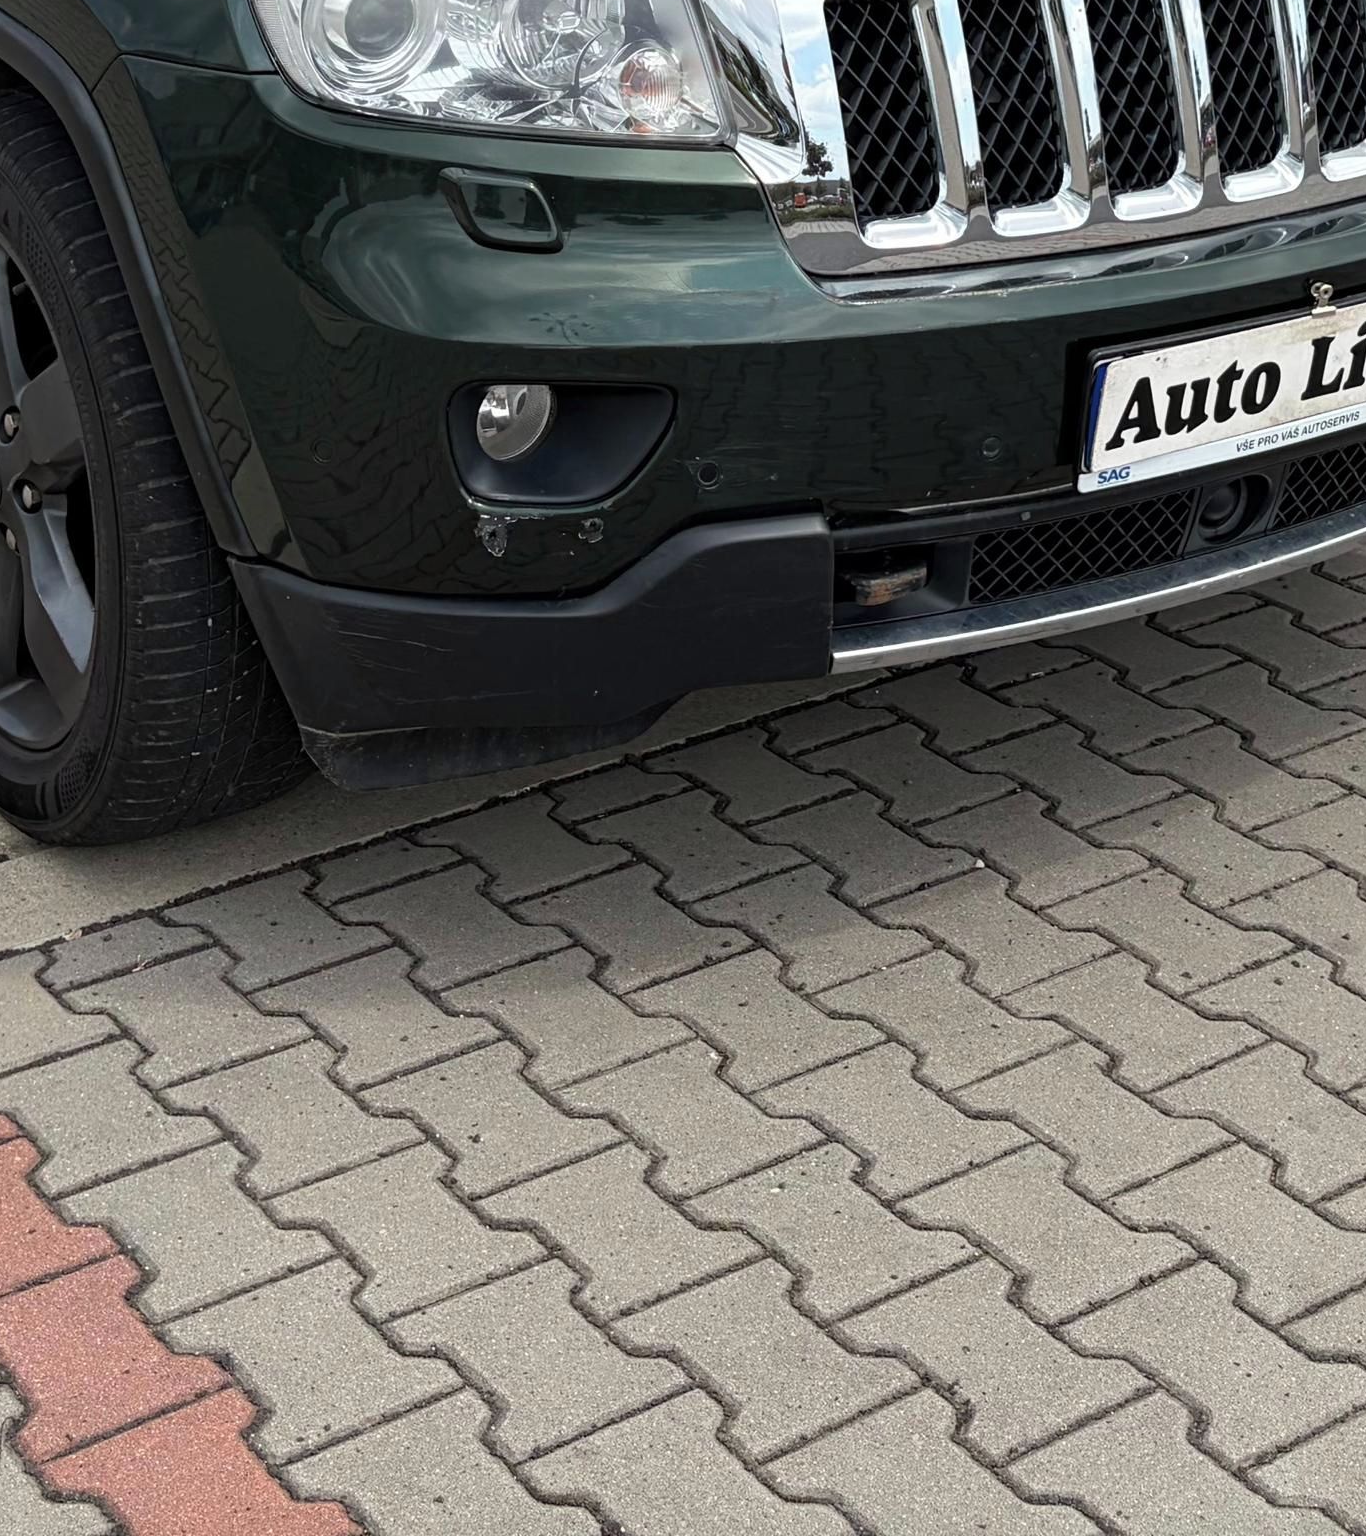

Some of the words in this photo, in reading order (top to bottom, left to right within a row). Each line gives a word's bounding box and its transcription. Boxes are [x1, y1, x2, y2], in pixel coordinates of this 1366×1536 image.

[1104, 359, 1282, 452] Auto
[1236, 438, 1255, 452] VŠE
[1257, 434, 1279, 447] PRO
[1281, 426, 1299, 441] VÁŠ
[1301, 410, 1361, 437] AUTOSERVIS
[1097, 465, 1131, 484] SAG
